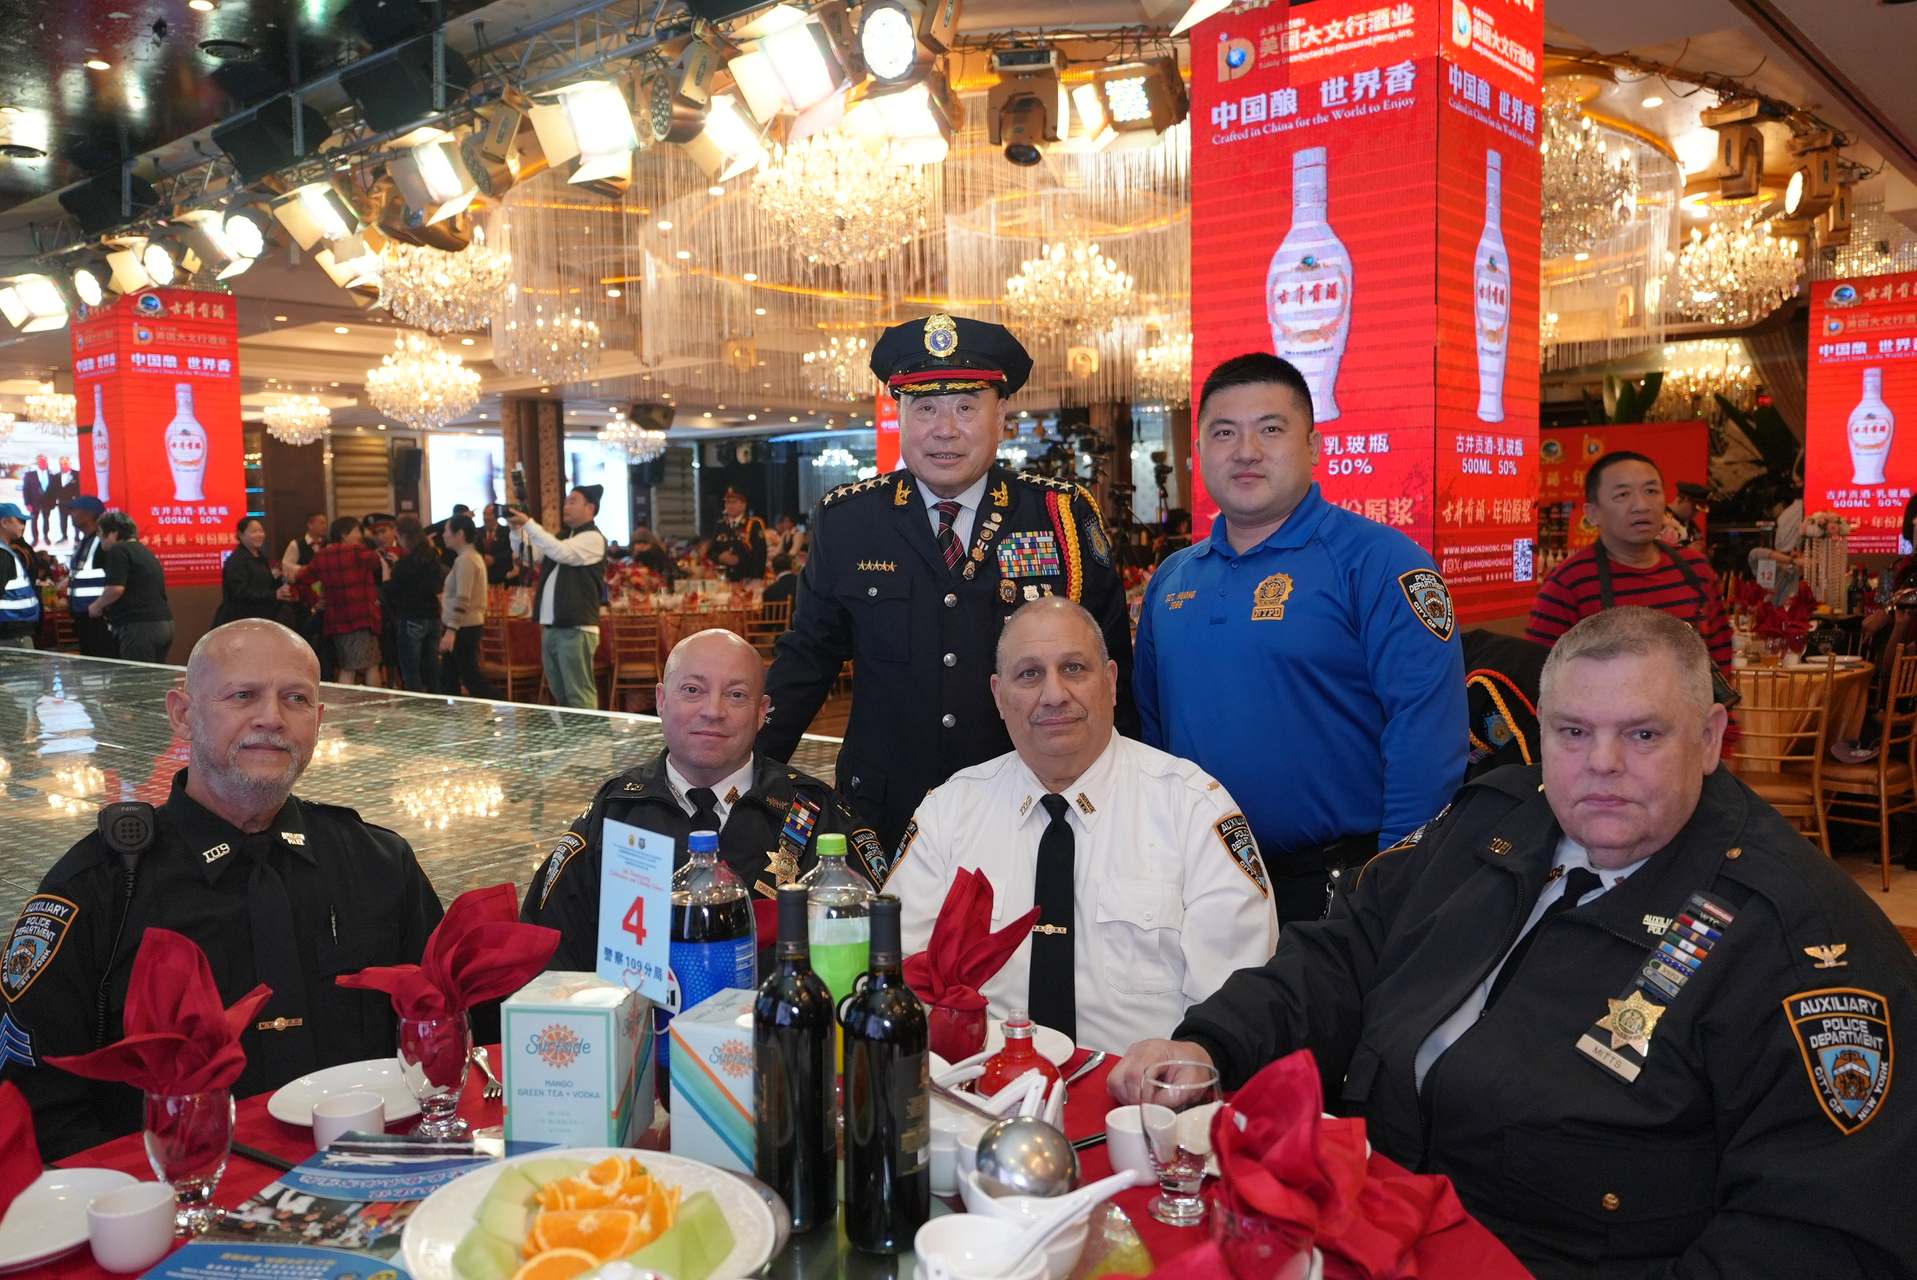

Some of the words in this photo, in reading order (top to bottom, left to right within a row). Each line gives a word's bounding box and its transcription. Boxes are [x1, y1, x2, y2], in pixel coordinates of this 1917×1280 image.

[1211, 87, 1298, 131] 中国酿
[1319, 60, 1416, 108] 世界香
[1448, 63, 1490, 110] 中国酿
[1499, 89, 1535, 134] 世界香
[1212, 129, 1249, 145] Crafted
[1250, 126, 1261, 138] in
[1263, 120, 1293, 135] China
[1296, 116, 1310, 129] for
[1312, 113, 1328, 125] the
[1332, 104, 1366, 121] World
[1368, 104, 1380, 114] to
[1383, 96, 1416, 112] Enjoy
[1879, 337, 1917, 353] 世界
[1323, 434, 1390, 455] 乳玻瓶
[1328, 459, 1373, 475] 50%
[1462, 458, 1492, 475] 500ML
[1498, 460, 1517, 476] 50%
[1833, 499, 1871, 509] 500ML
[1878, 499, 1902, 508] 50%
[158, 516, 193, 525] 500ML
[200, 516, 222, 524] 50%
[1255, 608, 1281, 618] NYPD
[202, 842, 231, 864] 109
[25, 900, 70, 917] AUXILIARY
[25, 917, 52, 929] POLICE
[622, 895, 647, 946] 4
[1700, 912, 1720, 926] WTC
[32, 948, 52, 972] YORK
[603, 946, 664, 983] 警察109分局
[1800, 996, 1878, 1017] AUXILIARY
[1822, 1018, 1869, 1034] POLICE
[1809, 1031, 1884, 1050] DEPARTMENT
[544, 1080, 574, 1088] MANGO
[1814, 1066, 1832, 1094] CITY
[1829, 1098, 1842, 1115] OF
[1857, 1096, 1877, 1121] NEW
[1873, 1061, 1889, 1095] YORK
[517, 1088, 544, 1097] GREEN
[547, 1089, 563, 1097] TEA
[572, 1091, 601, 1099] VODKA
